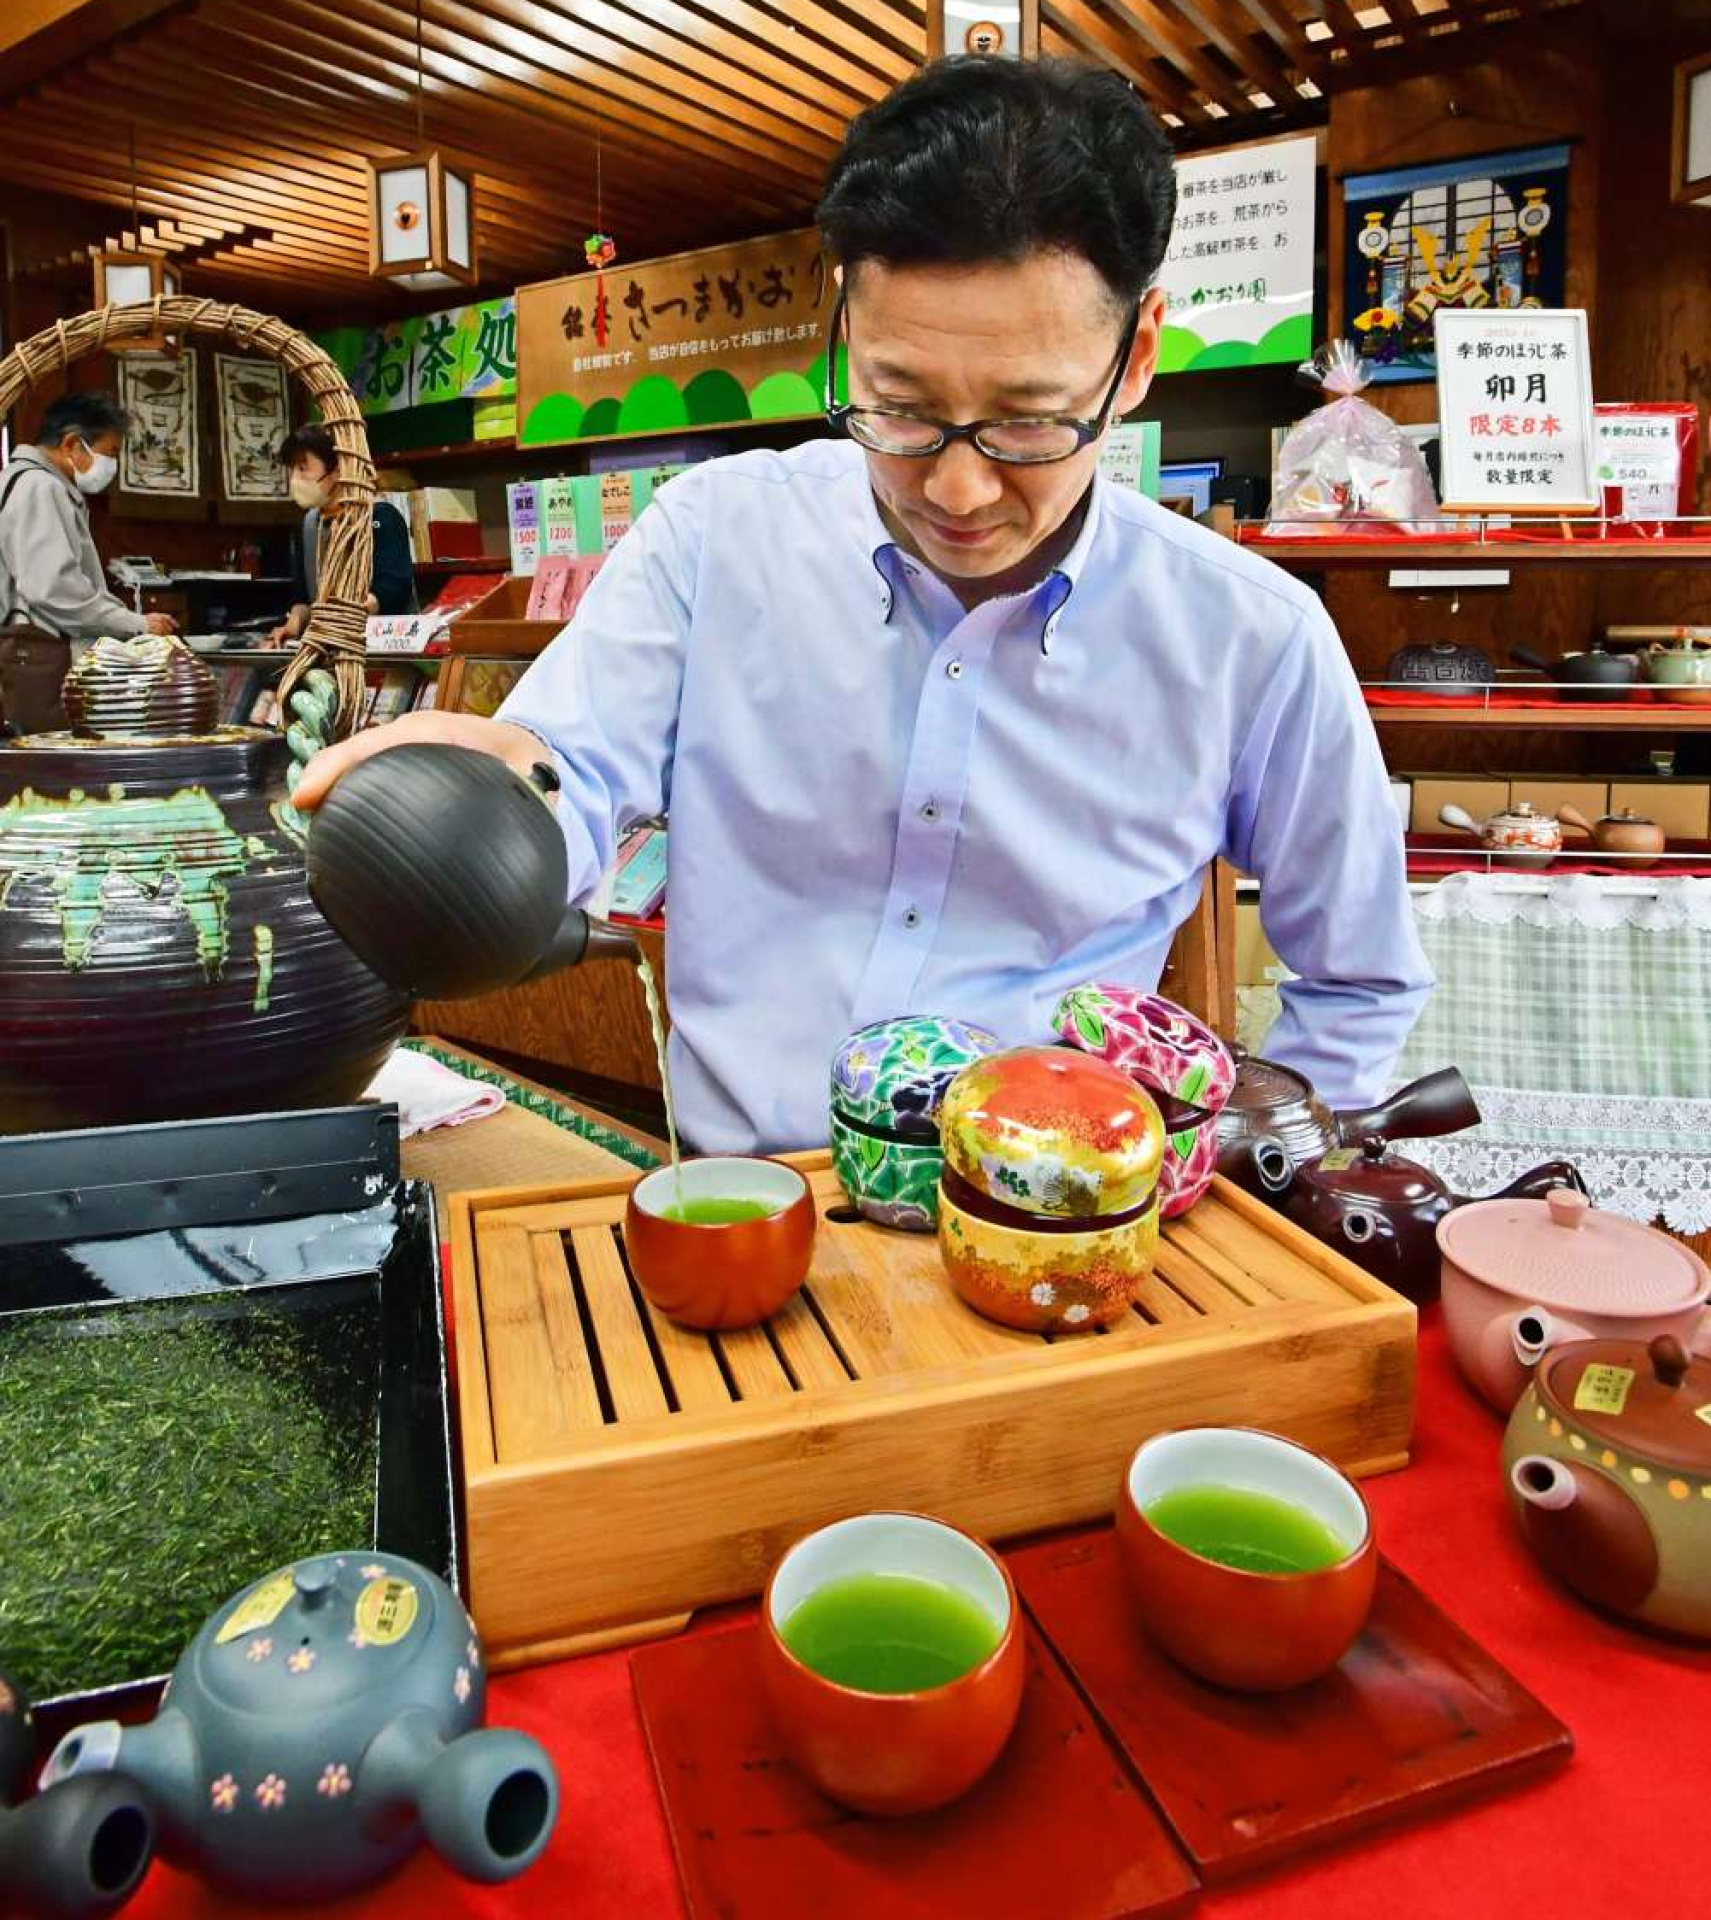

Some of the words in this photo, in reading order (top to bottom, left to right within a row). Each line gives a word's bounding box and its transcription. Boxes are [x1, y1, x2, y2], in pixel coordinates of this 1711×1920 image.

[1177, 168, 1288, 199] 番茶を当店が厳し
[366, 309, 516, 398] お茶処
[1457, 341, 1567, 360] 季節のほうじ茶
[1485, 373, 1547, 403] 卯月
[1469, 414, 1562, 437] 限定8本
[1486, 469, 1553, 485] 数量限定
